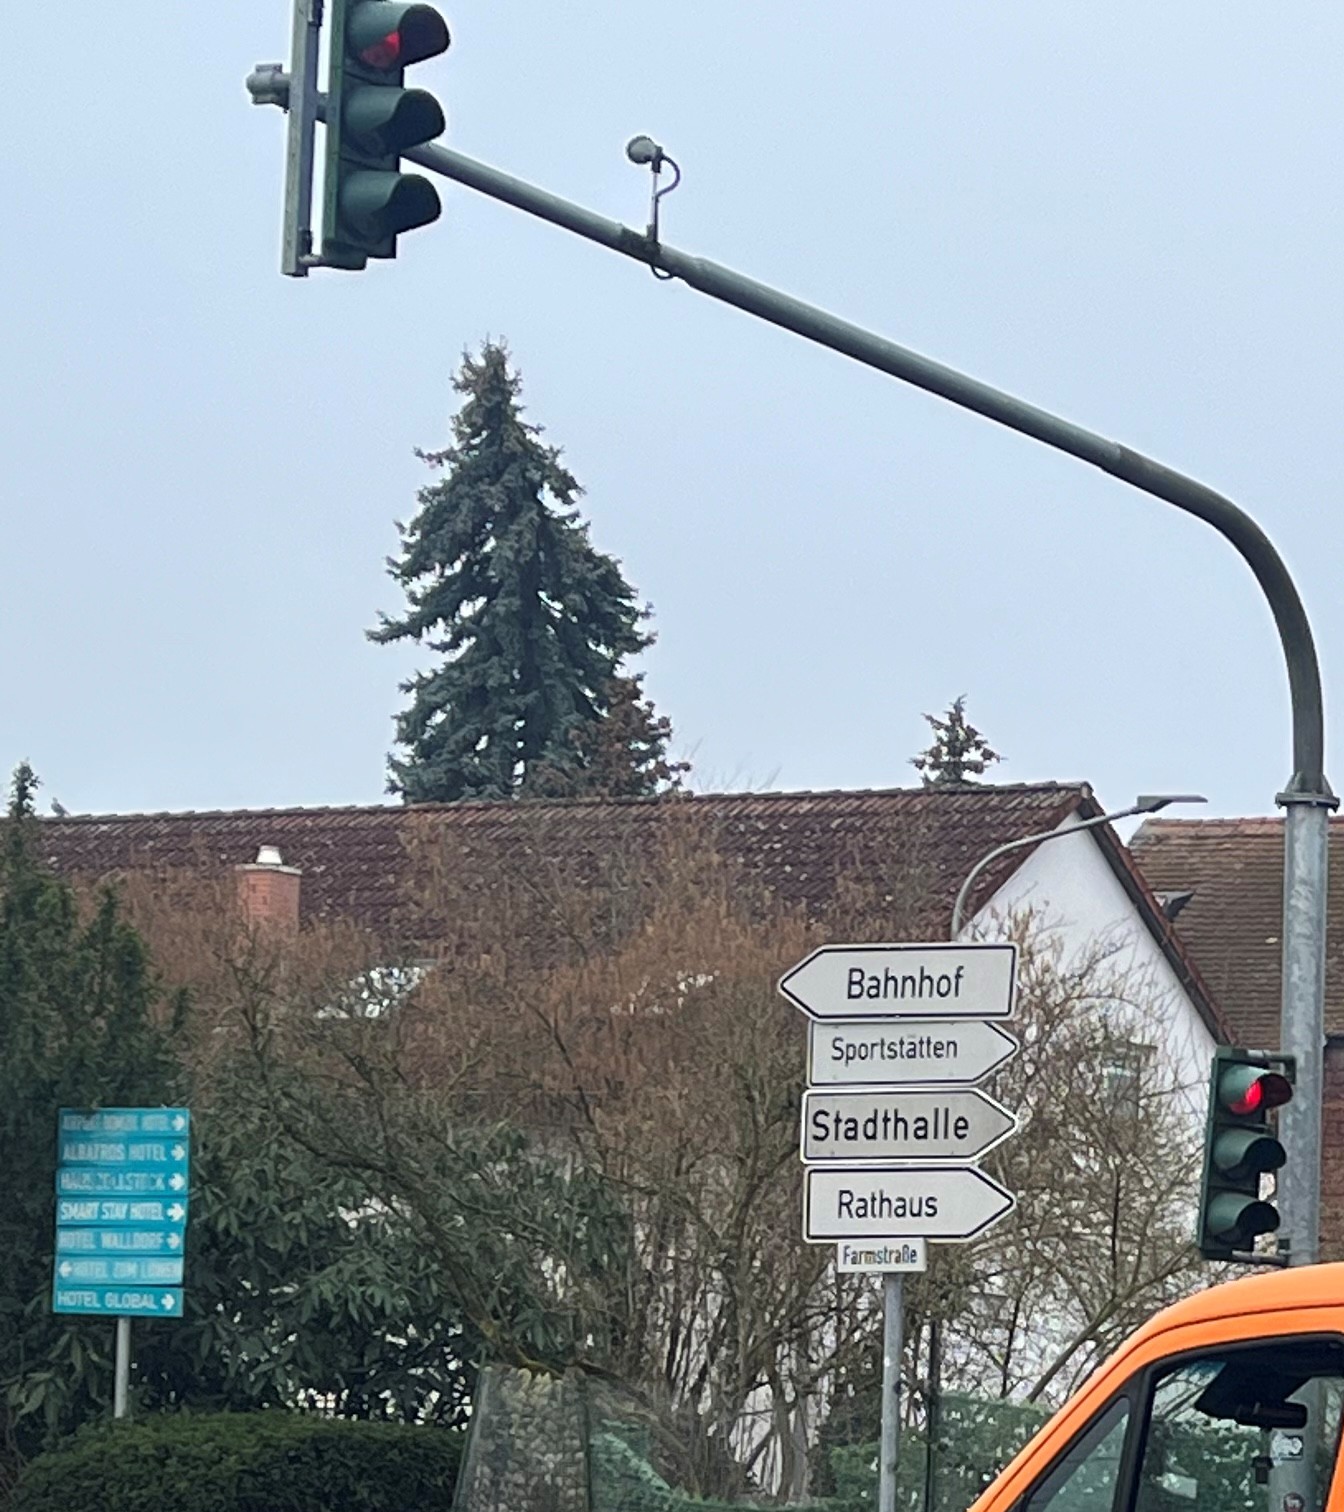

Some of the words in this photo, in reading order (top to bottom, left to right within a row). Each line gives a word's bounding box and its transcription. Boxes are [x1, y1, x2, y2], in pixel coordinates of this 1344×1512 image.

[846, 965, 965, 1000] Bahnhof
[831, 1034, 958, 1067] Sportstätten
[811, 1107, 970, 1142] Stadthalle
[128, 1144, 167, 1161] HOTEL
[101, 1202, 128, 1220] STAY
[837, 1189, 939, 1219] Rathaus
[843, 1244, 917, 1265] Farmstraße
[57, 1290, 102, 1308] HOTEL
[104, 1292, 159, 1310] GLOBAL
